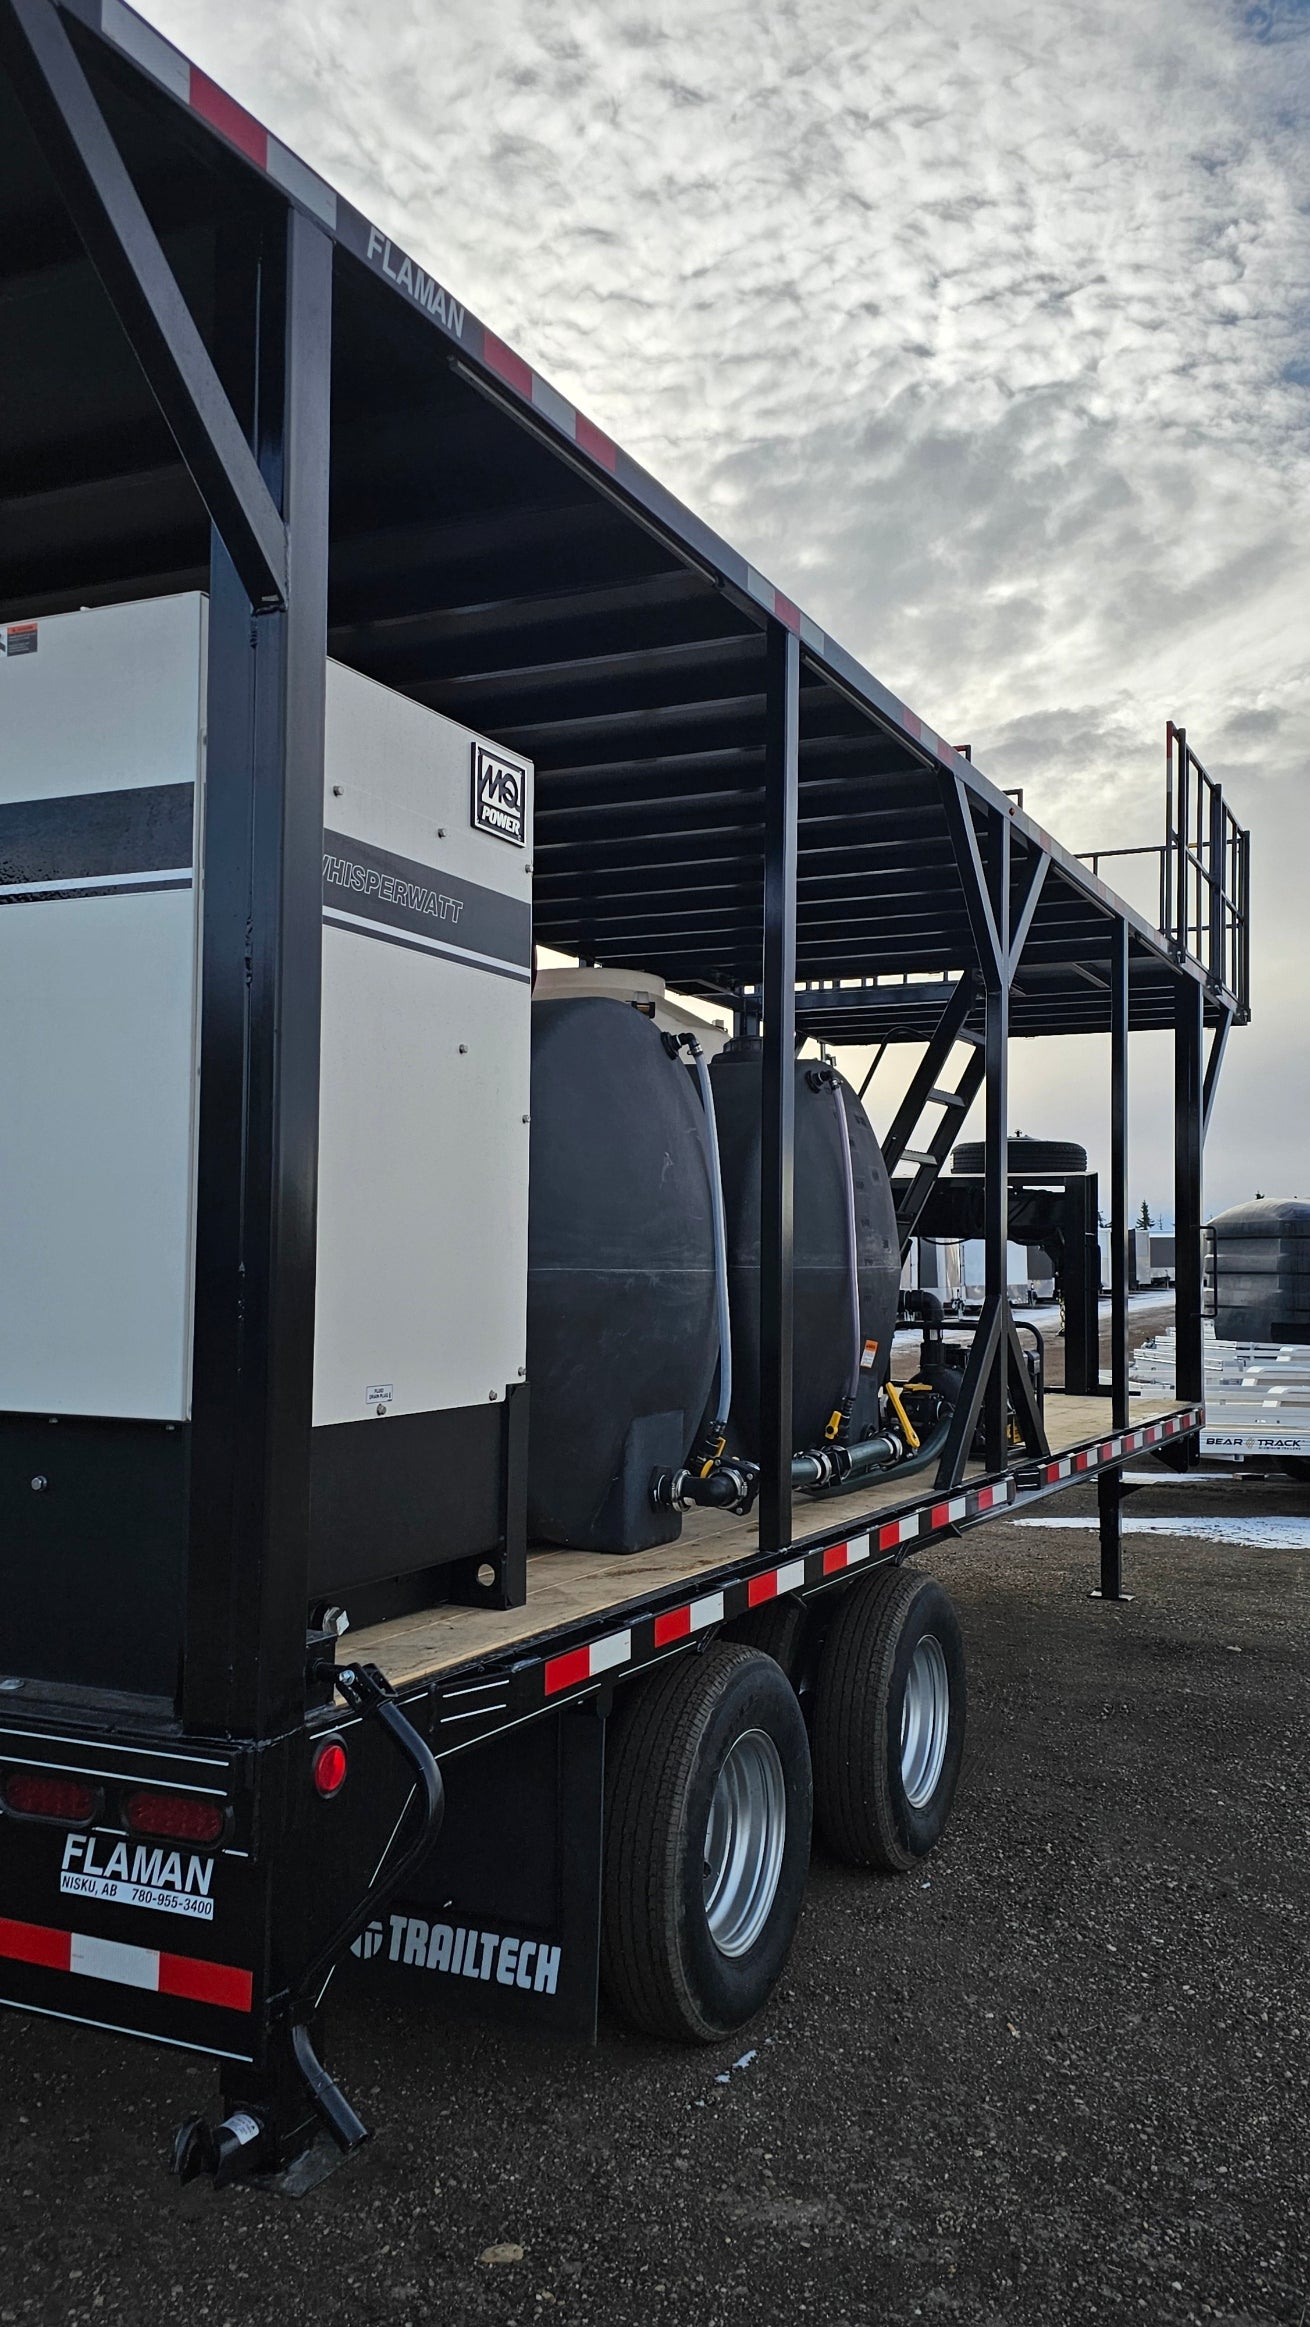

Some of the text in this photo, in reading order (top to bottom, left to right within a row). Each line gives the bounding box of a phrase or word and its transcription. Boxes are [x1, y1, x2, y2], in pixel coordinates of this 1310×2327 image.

[366, 226, 465, 339] FLAMAN
[479, 764, 521, 812] MQ
[482, 805, 521, 835] POWER
[1206, 1438, 1301, 1447] BEAR TRACK
[61, 1833, 215, 1896] FLAMAN
[61, 1875, 212, 1915] NISKU, AB 780-955-3400
[388, 1914, 562, 1995] TRAILTECH
